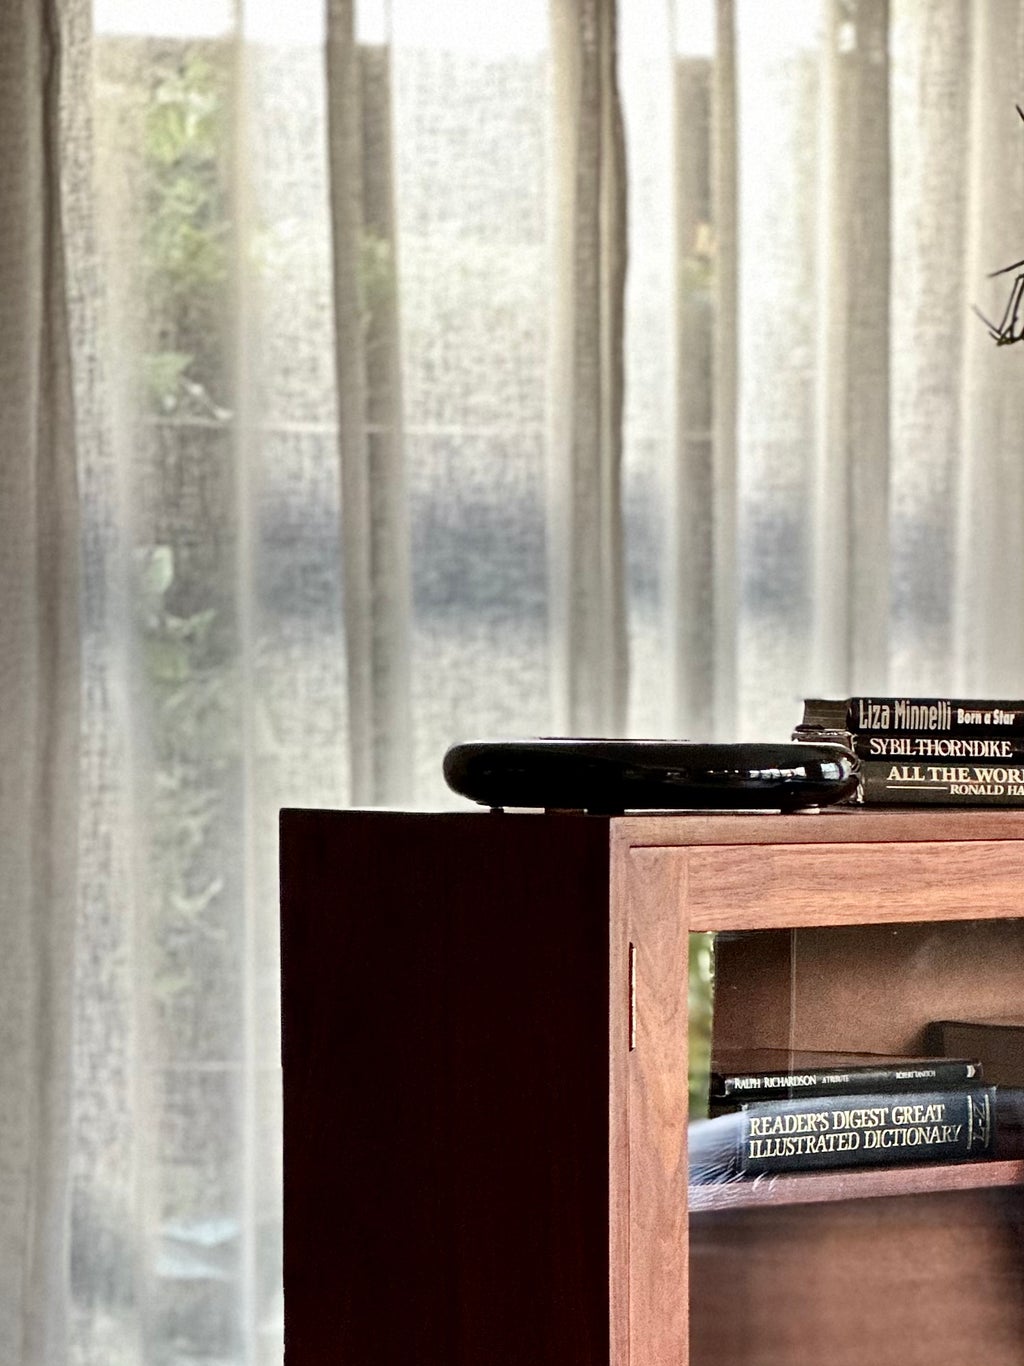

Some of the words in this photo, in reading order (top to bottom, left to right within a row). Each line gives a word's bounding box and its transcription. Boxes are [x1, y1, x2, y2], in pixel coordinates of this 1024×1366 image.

[859, 699, 890, 729] Liza
[894, 700, 951, 730] Minnelli
[957, 708, 981, 724] Born
[984, 712, 991, 725] a
[993, 709, 1015, 725] Star
[869, 737, 916, 756] SYBIL
[915, 738, 1013, 758] THORNDIKE
[886, 766, 925, 781] ALL
[927, 767, 971, 782] THE
[950, 784, 1004, 796] RONALD
[734, 1077, 761, 1089] RALPH
[764, 1075, 817, 1088] RICHARDSON
[749, 1112, 830, 1137] READER'S
[832, 1108, 889, 1130] DIGEST
[892, 1104, 945, 1125] GREAT
[748, 1131, 860, 1159] ILLUSTRATED
[863, 1124, 962, 1149] DICTIONARY
